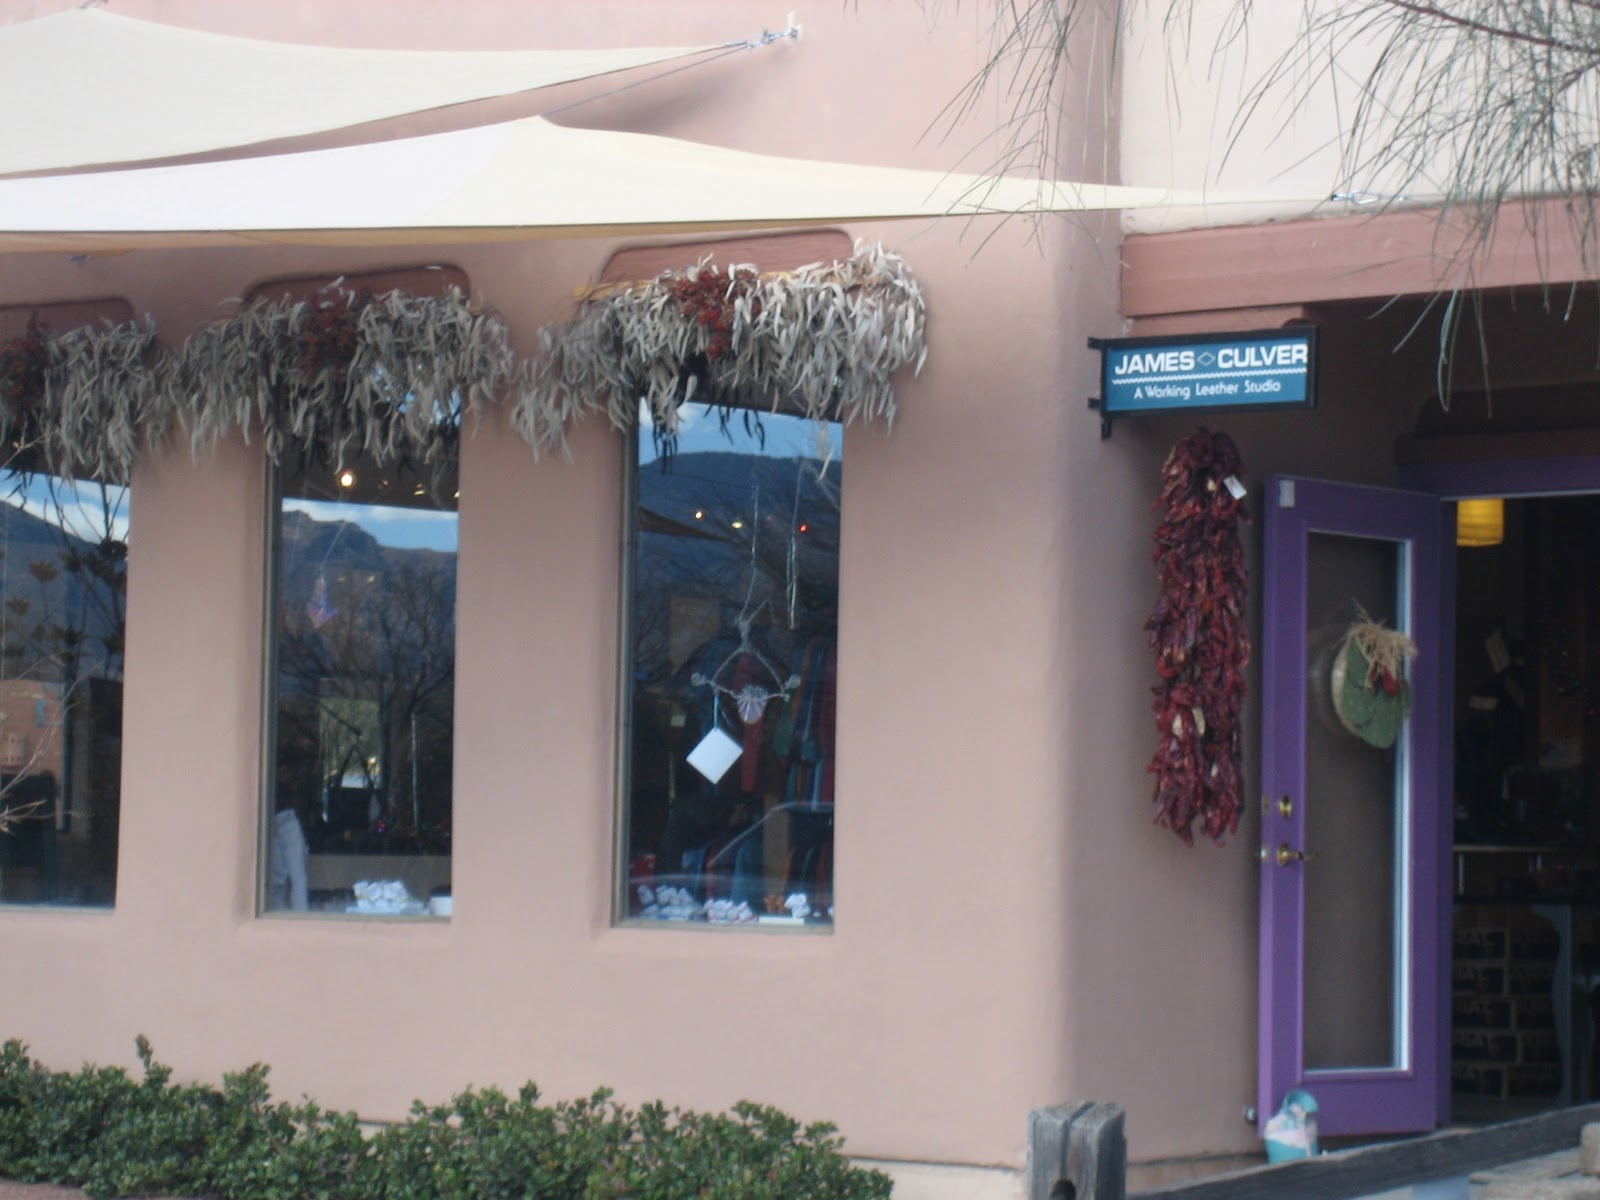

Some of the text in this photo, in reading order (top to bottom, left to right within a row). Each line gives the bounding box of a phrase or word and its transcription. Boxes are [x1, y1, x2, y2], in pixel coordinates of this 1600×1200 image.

[1115, 343, 1308, 375] JAMES CULVER
[1133, 379, 1282, 400] A Working Leather Studio
